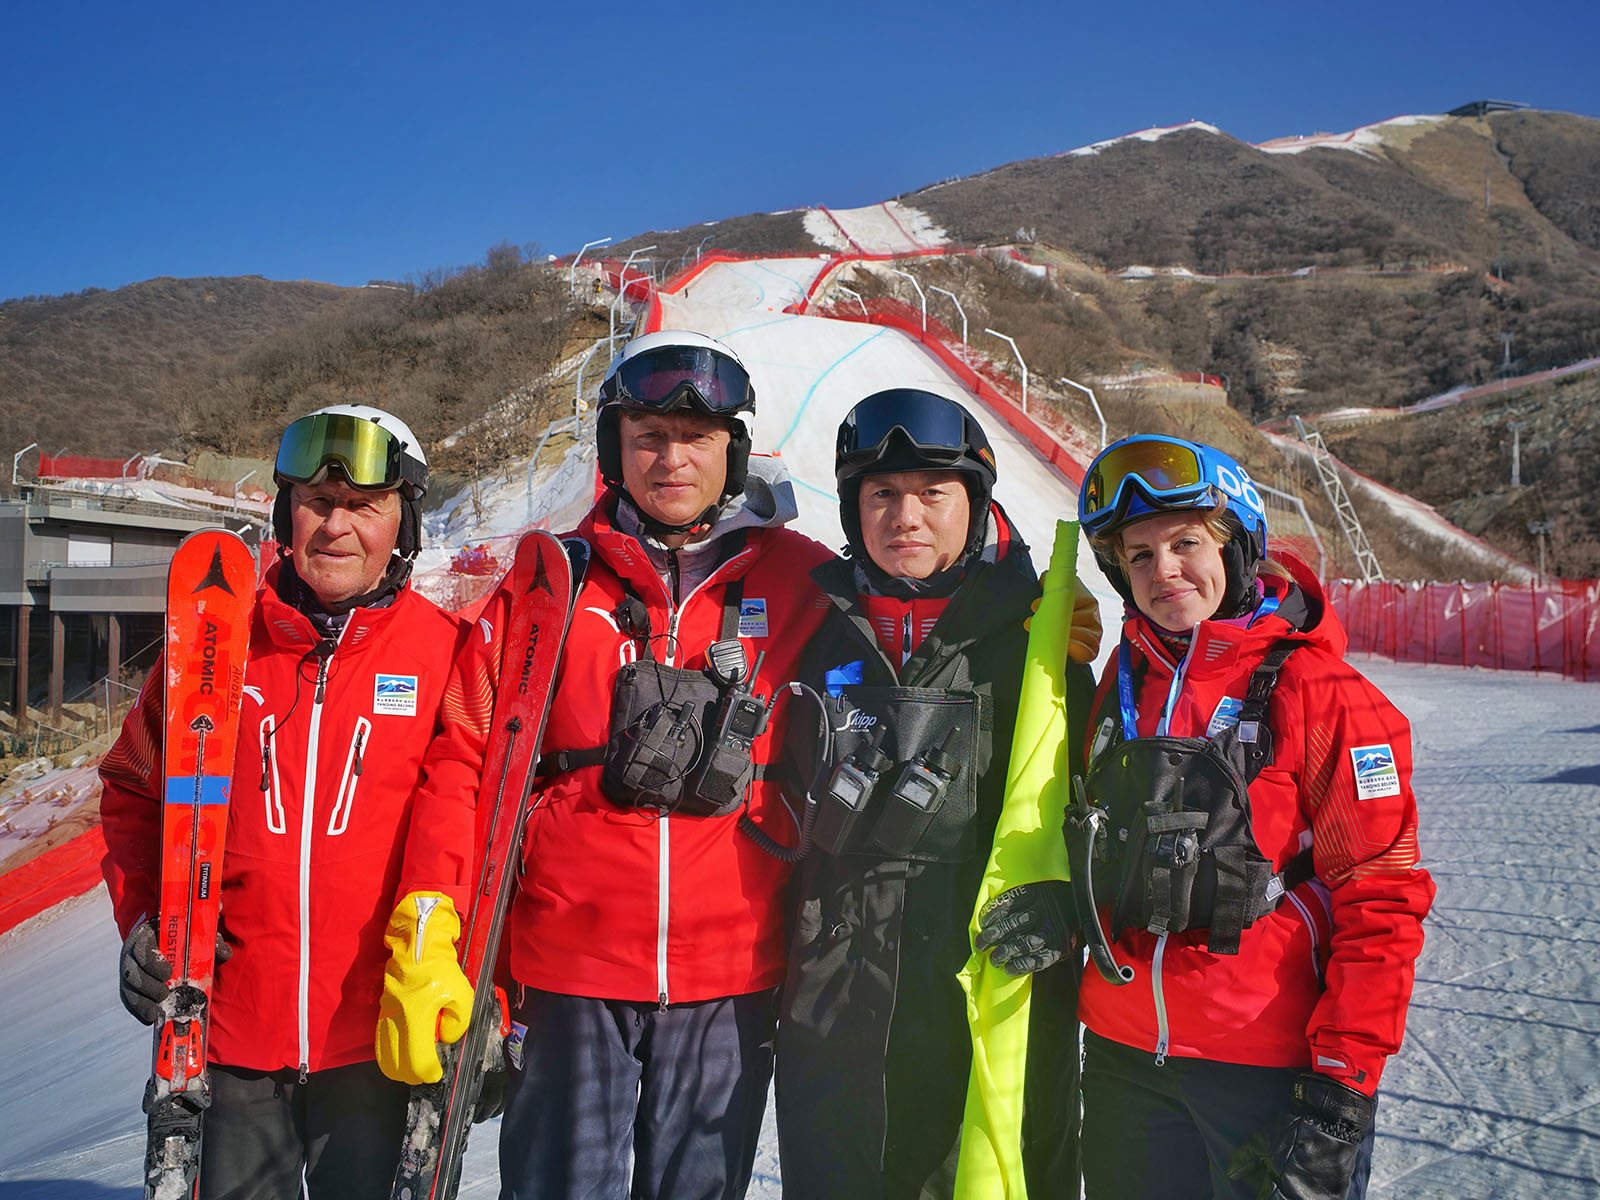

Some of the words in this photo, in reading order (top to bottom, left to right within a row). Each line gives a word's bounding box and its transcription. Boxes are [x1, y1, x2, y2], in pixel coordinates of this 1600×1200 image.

[200, 621, 217, 695] ATOMIC
[519, 624, 539, 695] ATOMIC
[836, 708, 878, 731] Skipp
[201, 867, 209, 898] TITANIUM
[981, 885, 1027, 916] DESCENTE
